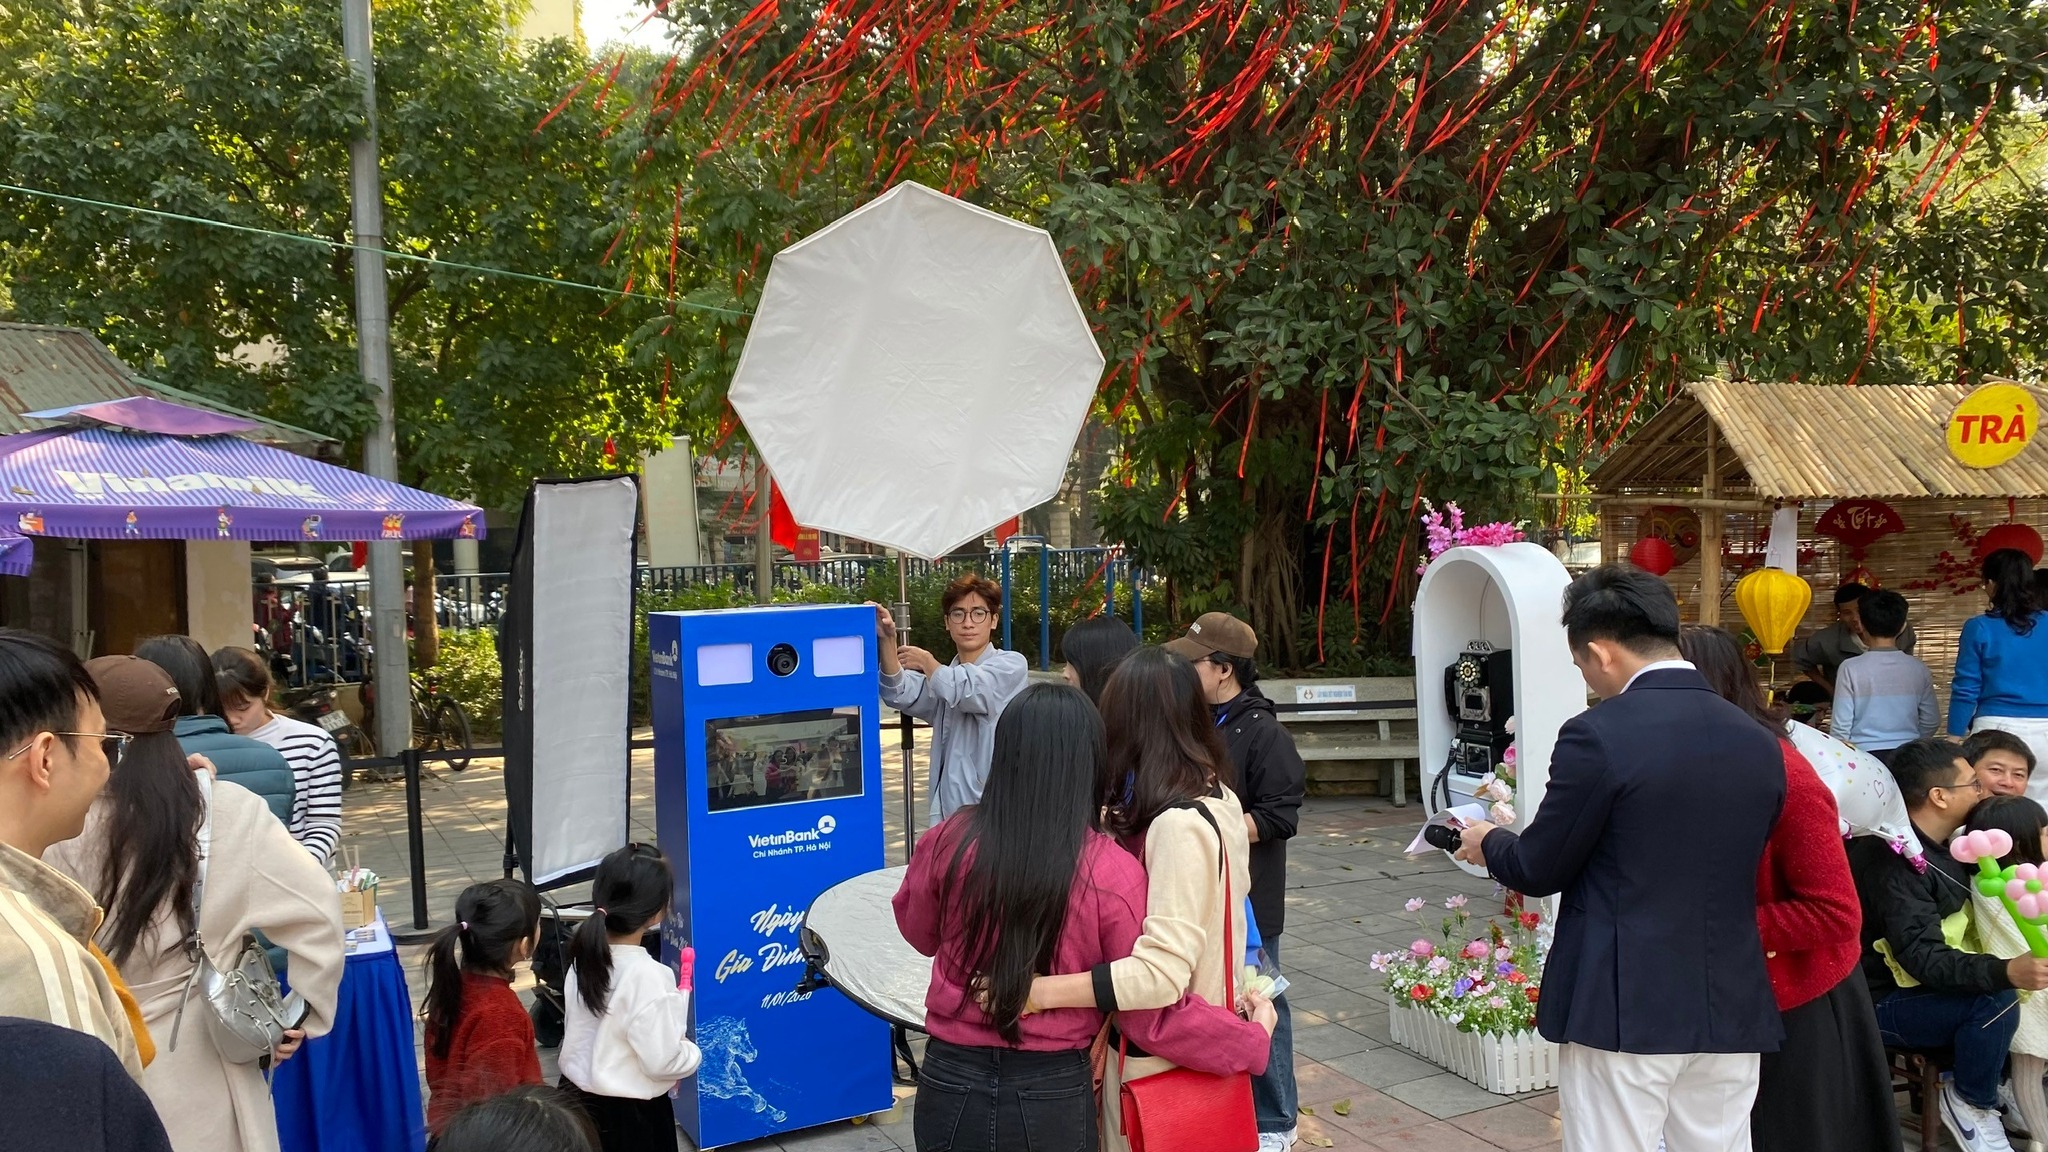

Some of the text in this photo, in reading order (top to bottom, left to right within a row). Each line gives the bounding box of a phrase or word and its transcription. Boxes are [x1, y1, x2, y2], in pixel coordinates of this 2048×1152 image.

[1956, 404, 2027, 444] TRÀ
[54, 469, 338, 503] Vinamilk
[748, 828, 820, 848] VietinBank
[752, 841, 831, 859] Chi Nhánh TP. Hà Nội
[750, 903, 805, 937] Ngày
[715, 949, 754, 984] Gia
